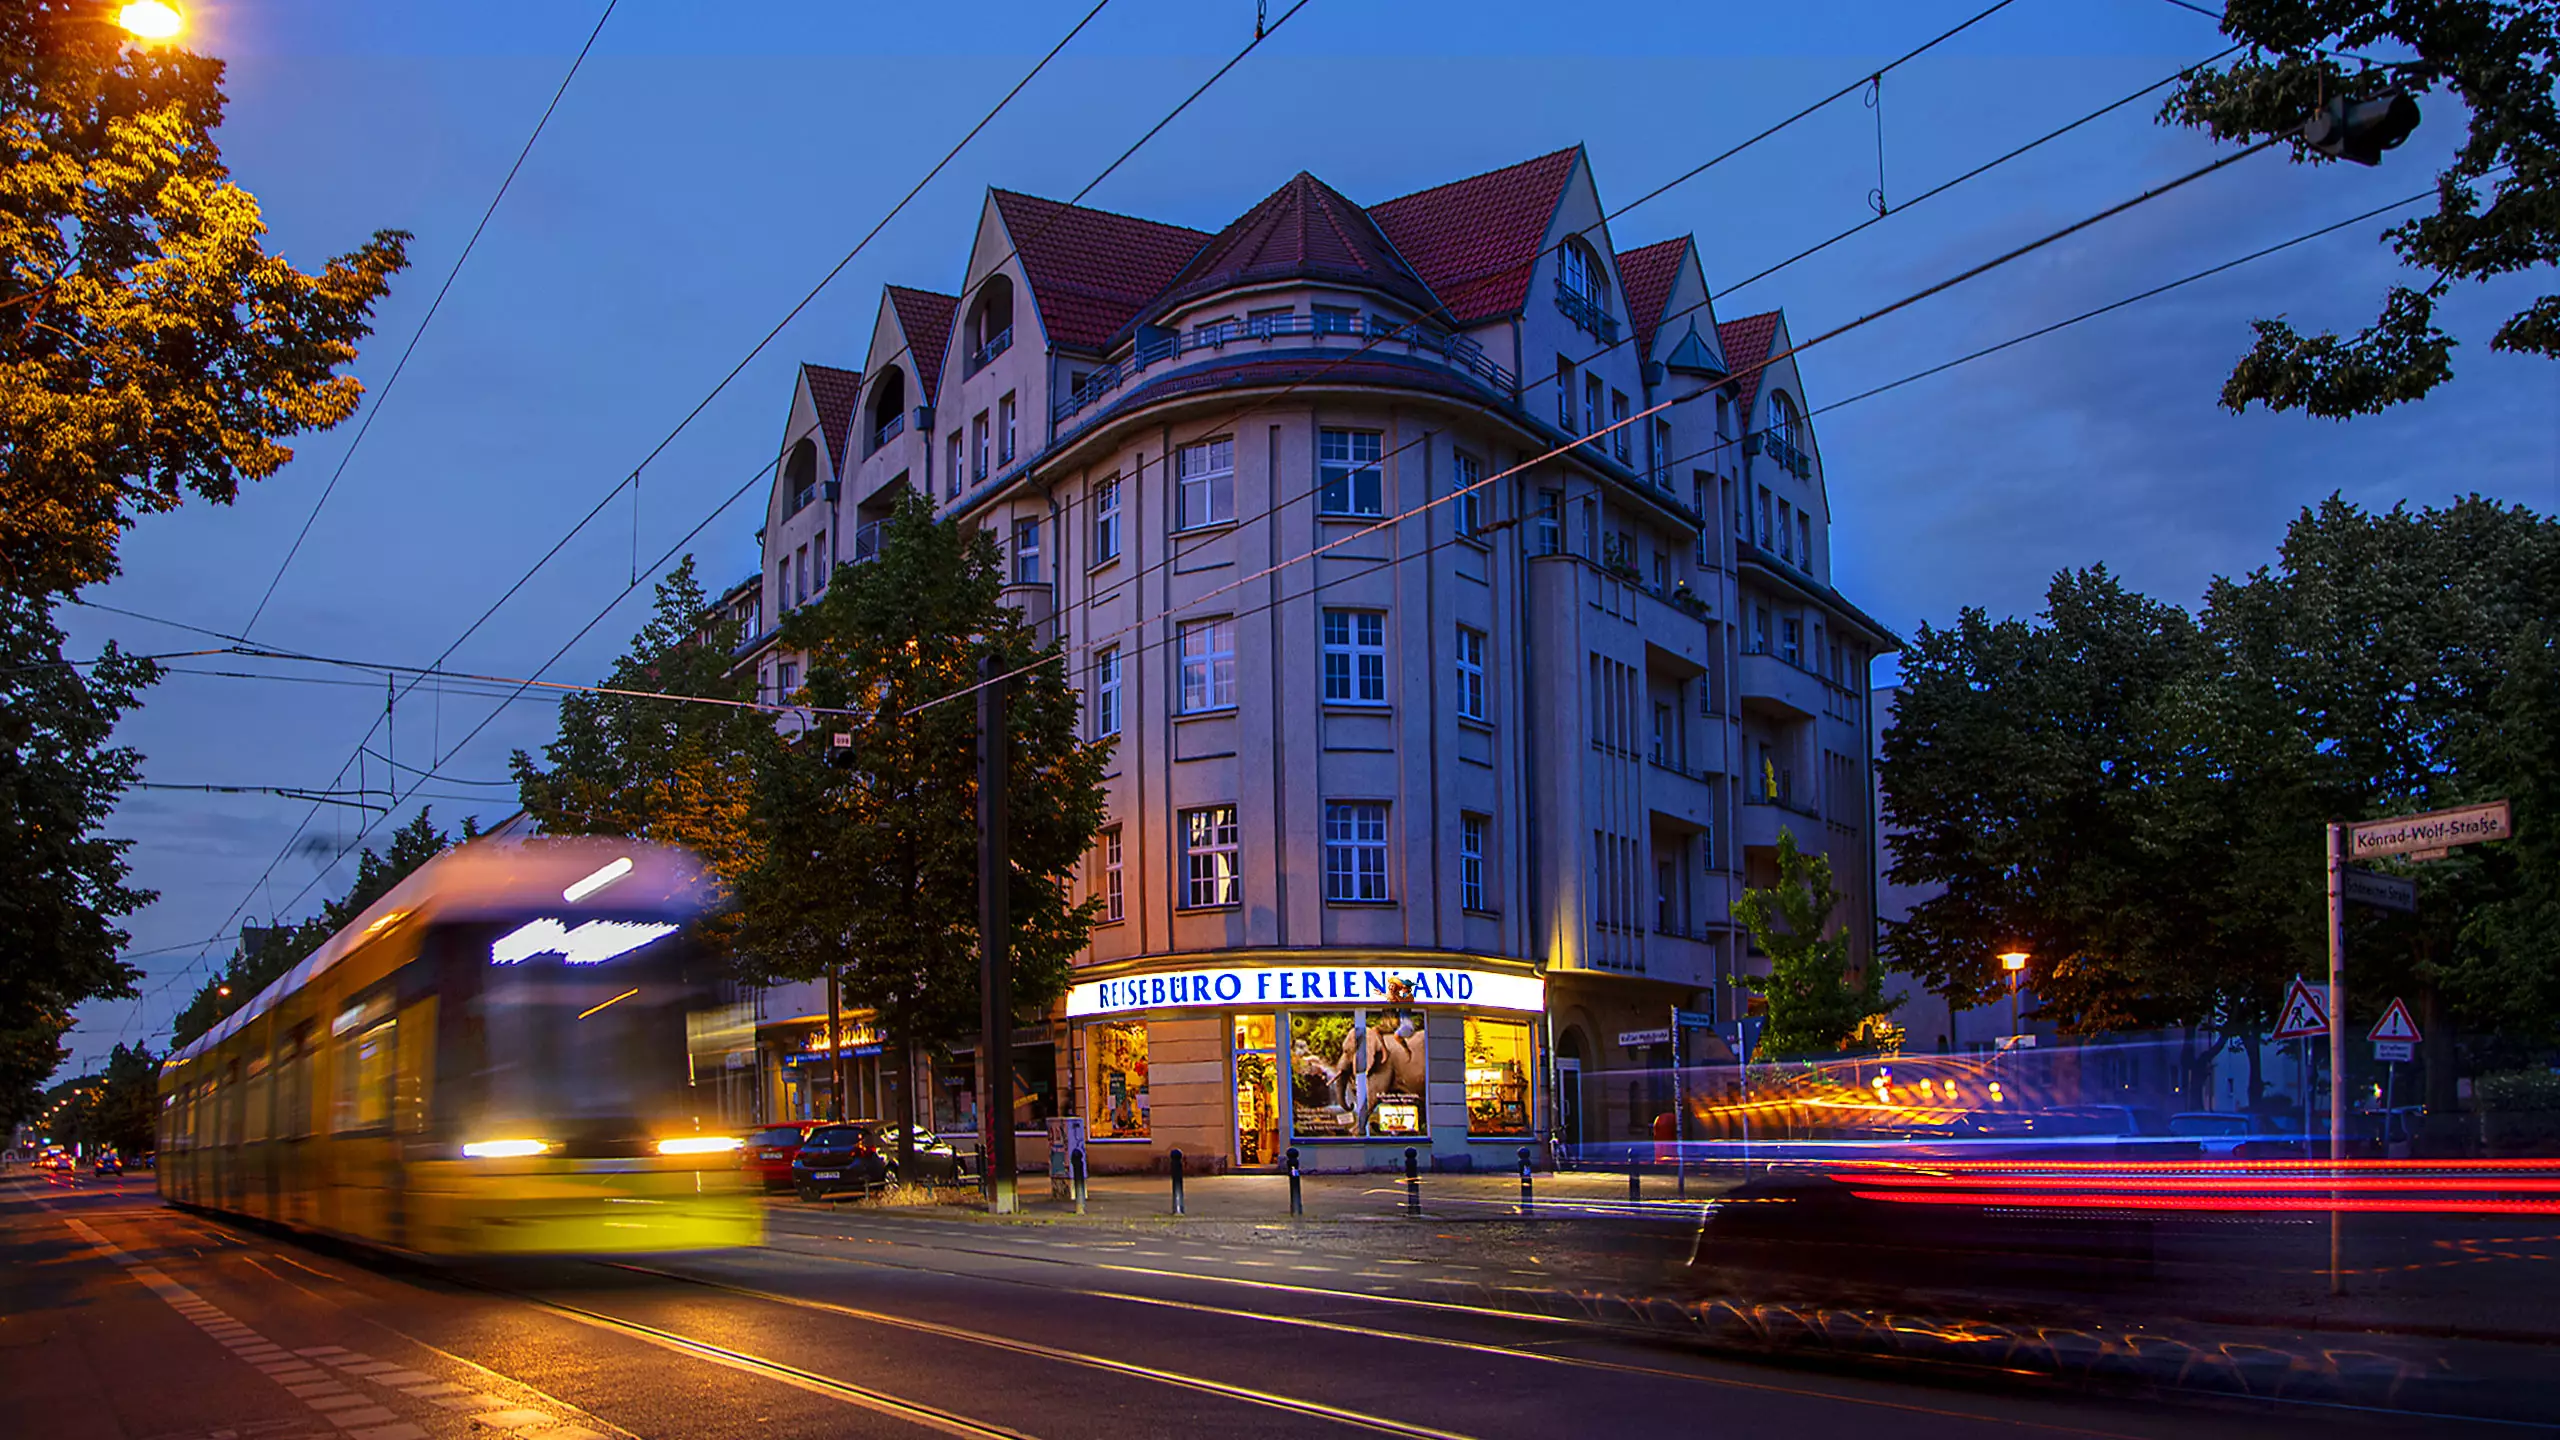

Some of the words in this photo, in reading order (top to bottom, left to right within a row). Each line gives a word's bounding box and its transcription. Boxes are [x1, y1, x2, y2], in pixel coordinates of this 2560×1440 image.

[2357, 816, 2498, 849] Konrad-Wolf-Straße
[1099, 973, 1242, 1009] REISEBÜRO
[1257, 971, 1473, 1000] FERIENAND
